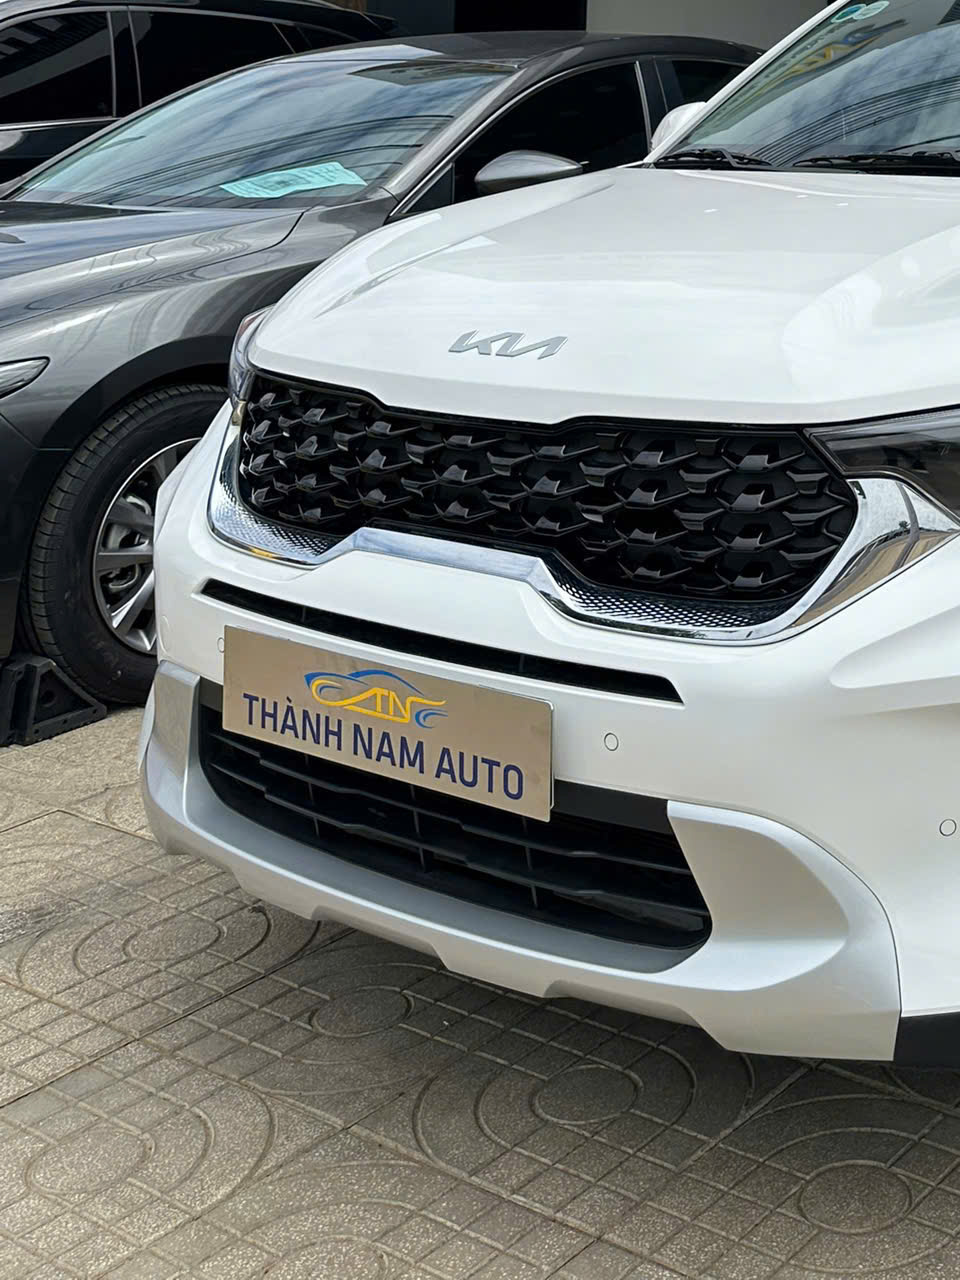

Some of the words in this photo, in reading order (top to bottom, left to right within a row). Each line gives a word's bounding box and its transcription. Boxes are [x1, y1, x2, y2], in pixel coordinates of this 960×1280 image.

[242, 692, 342, 751] THÀNH
[353, 723, 425, 775] NAM
[435, 746, 524, 800] AUTO
